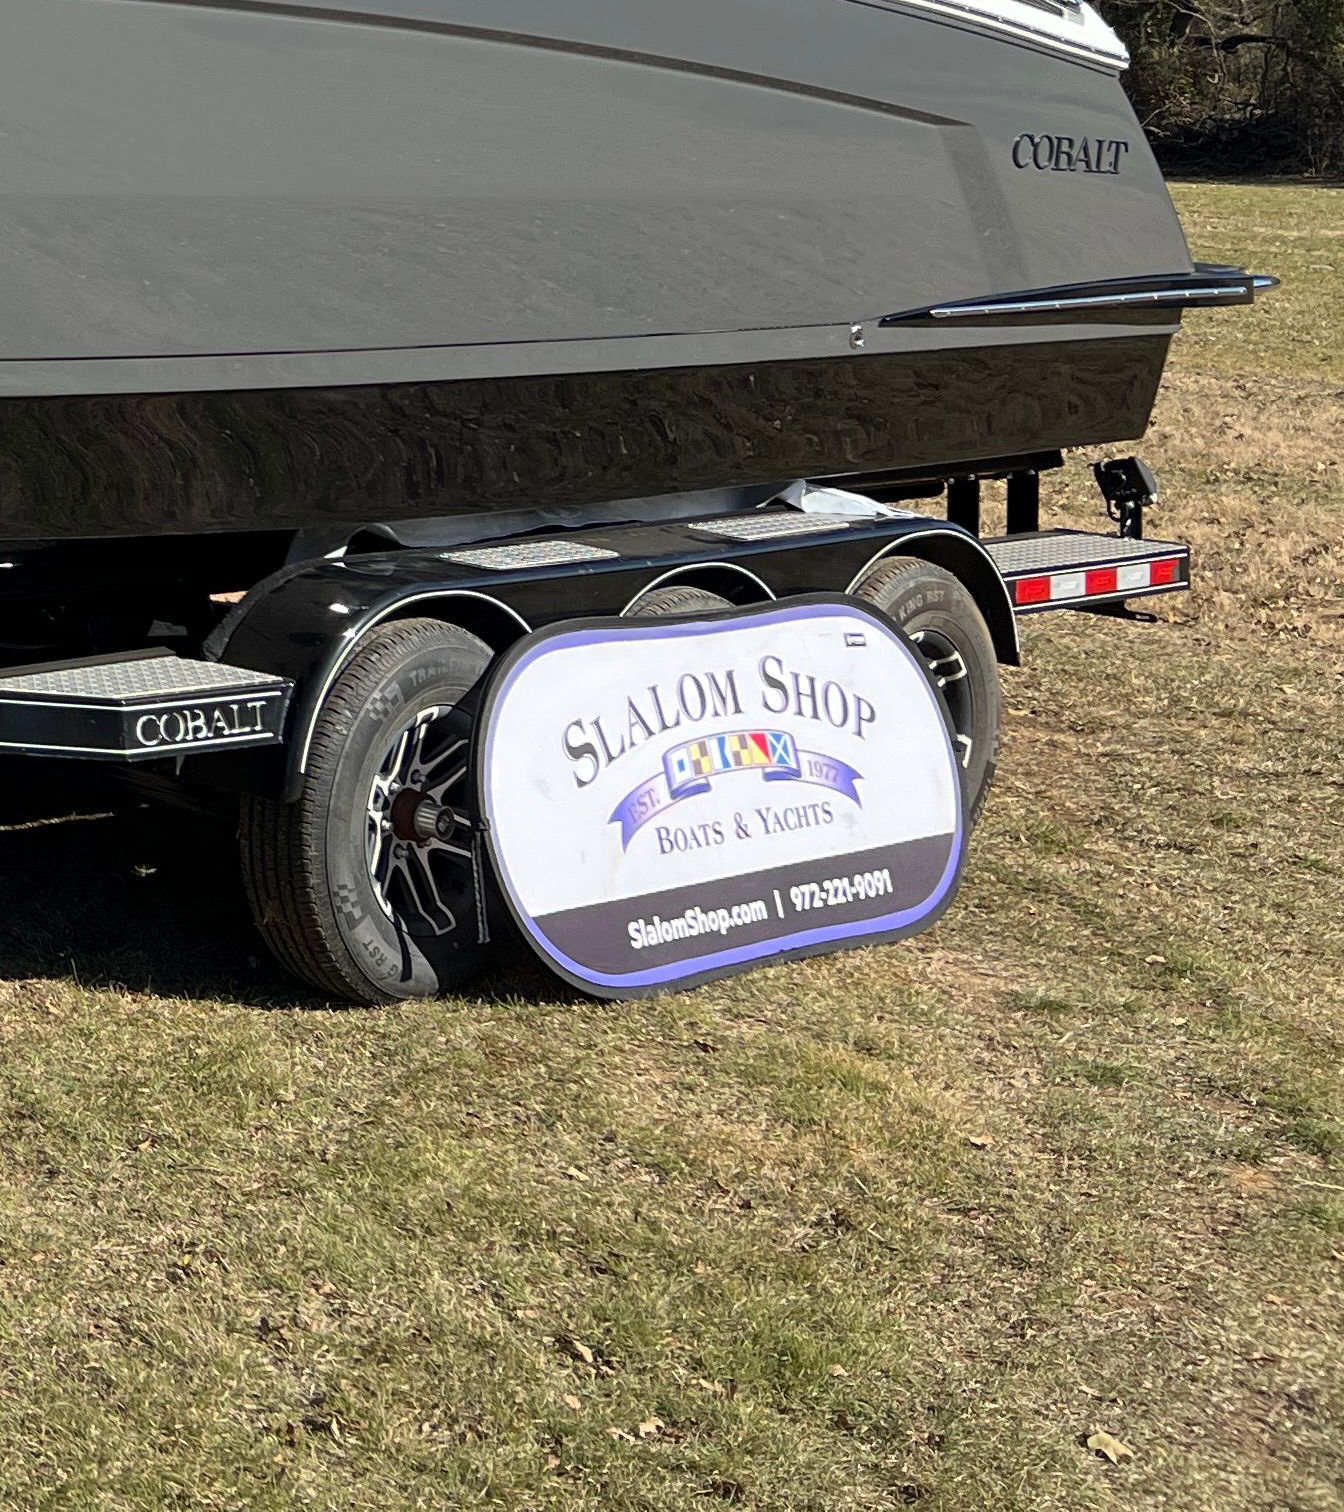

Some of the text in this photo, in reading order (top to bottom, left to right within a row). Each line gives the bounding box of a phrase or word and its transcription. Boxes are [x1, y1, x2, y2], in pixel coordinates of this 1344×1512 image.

[1012, 133, 1129, 175] COBALT
[898, 595, 924, 622] KING
[136, 701, 267, 745] COBALT
[562, 655, 876, 788] SLALOM SHOP
[807, 760, 839, 784] 1977
[628, 788, 661, 823] EST.
[655, 801, 834, 855] BOATS & YACHTS
[627, 899, 768, 949] SlalomShop.com
[790, 868, 893, 912] 972-221-9091
